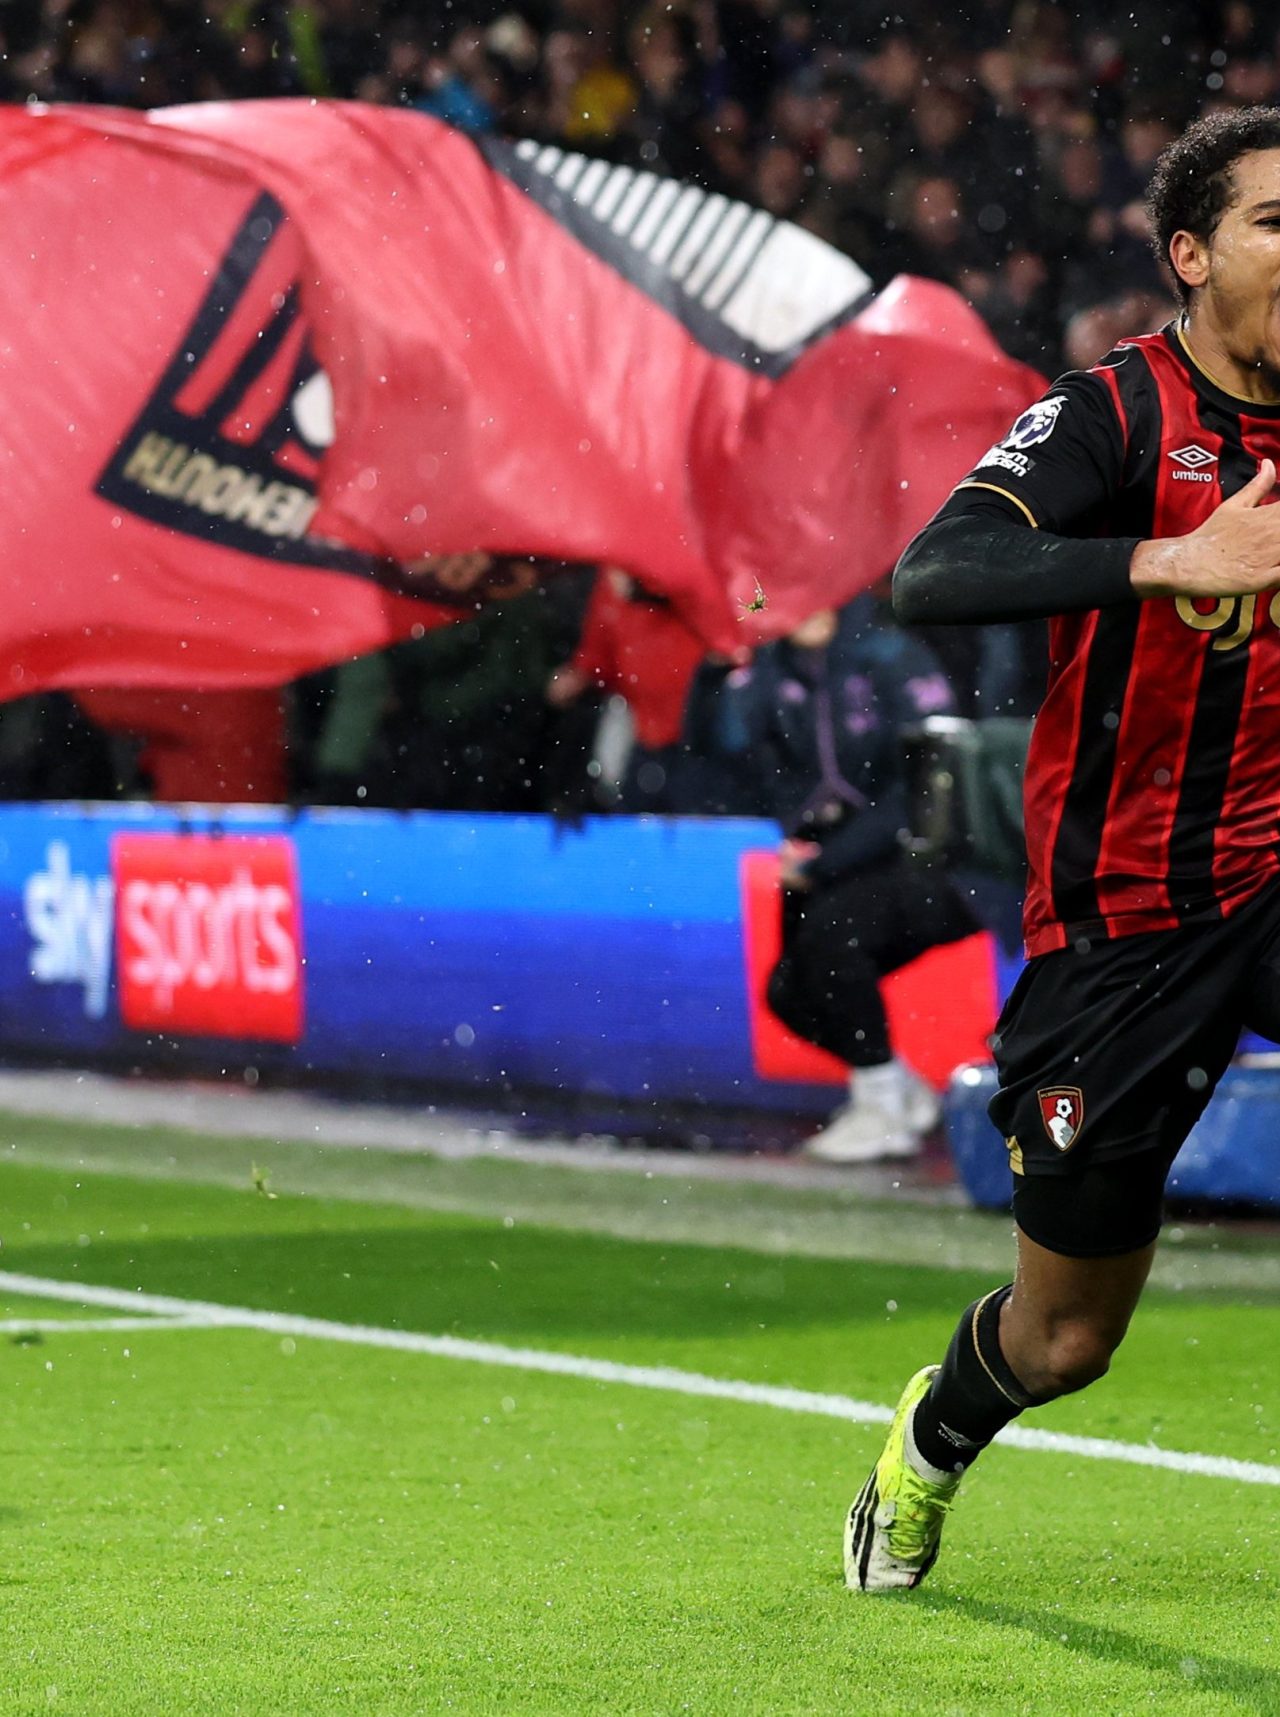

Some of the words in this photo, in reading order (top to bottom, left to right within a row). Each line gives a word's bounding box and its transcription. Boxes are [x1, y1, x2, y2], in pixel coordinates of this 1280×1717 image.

[1172, 469, 1213, 482] umbro
[24, 838, 116, 1020] sky
[120, 864, 298, 1015] sports
